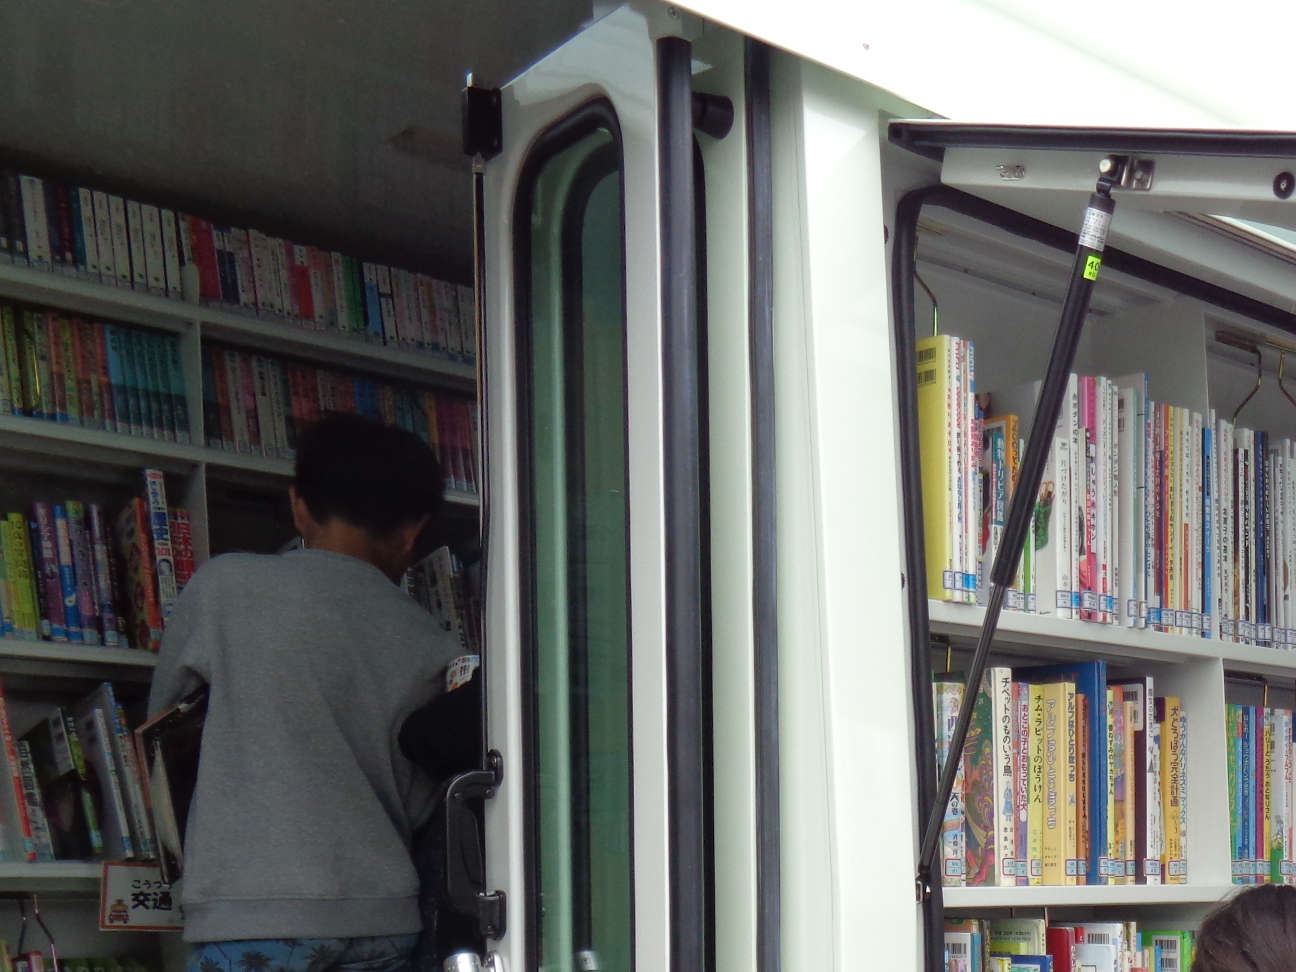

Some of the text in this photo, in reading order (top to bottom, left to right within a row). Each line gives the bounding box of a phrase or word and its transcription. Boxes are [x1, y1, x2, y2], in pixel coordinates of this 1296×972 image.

[1033, 694, 1044, 804] チム・ラビットのぼうけん
[1046, 698, 1057, 829] アルフはひとりぼっち
[1067, 691, 1076, 783] アルフはひとりぼっち
[1169, 705, 1179, 807] 犬どろぼう完全計画
[130, 890, 173, 911] 交通
